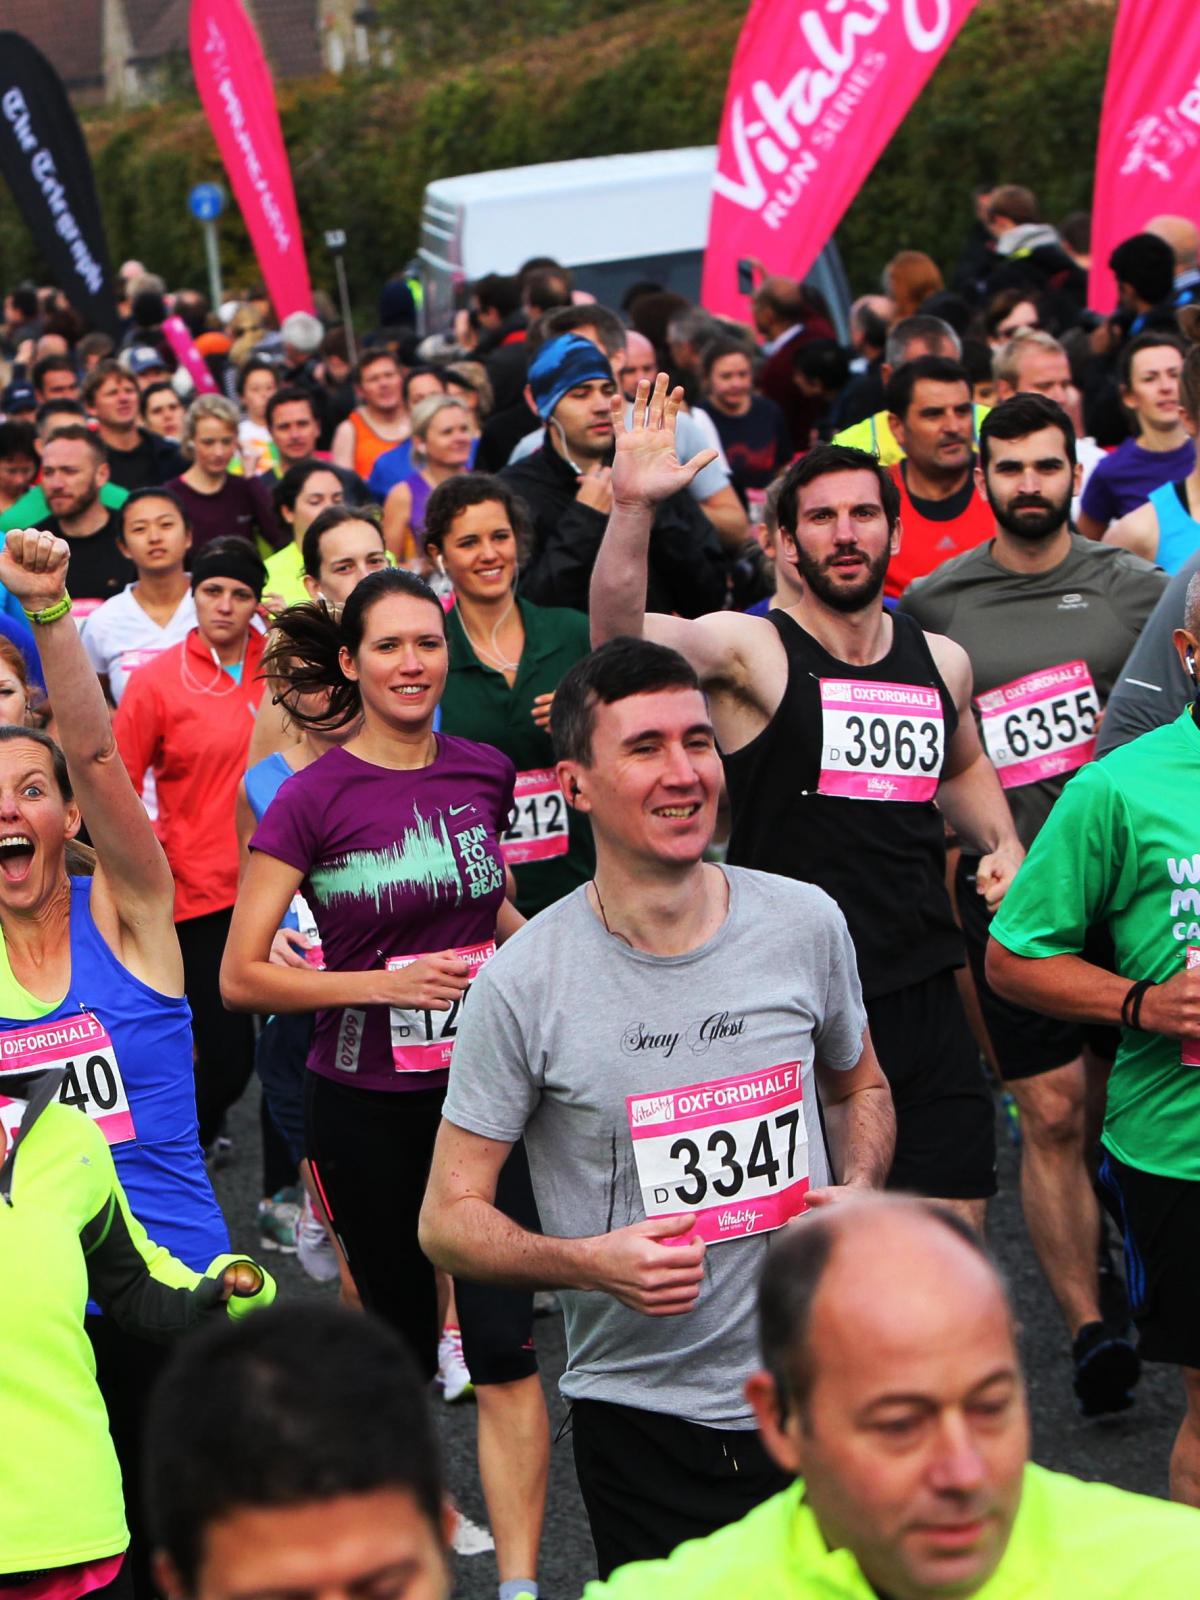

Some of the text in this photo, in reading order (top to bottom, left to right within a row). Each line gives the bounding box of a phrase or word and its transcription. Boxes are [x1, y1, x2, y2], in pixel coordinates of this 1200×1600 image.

[2, 86, 38, 151] The
[711, 0, 950, 209] Vitali
[762, 52, 886, 229] RUN SERIES
[853, 687, 934, 706] OXFORDHALF
[1004, 691, 1096, 757] 6355
[830, 748, 840, 760] D
[845, 716, 939, 772] 3963
[504, 794, 564, 840] 212
[454, 823, 488, 850] RUN
[460, 843, 485, 866] TO
[465, 855, 497, 882] THE
[1166, 853, 1200, 885] W
[468, 868, 503, 899] BEAT
[1169, 887, 1200, 917] M
[1172, 921, 1200, 941] CA
[464, 946, 493, 966] DHALF
[414, 983, 473, 1041] 12
[339, 1014, 359, 1067] 07609
[400, 1026, 411, 1038] D
[686, 1010, 749, 1057] Ghost
[59, 1055, 118, 1114] 40
[632, 1070, 794, 1123] Vitality OXFORDHALF
[669, 1108, 799, 1206] 3347
[654, 1187, 669, 1204] D
[717, 1208, 764, 1233] Vitality
